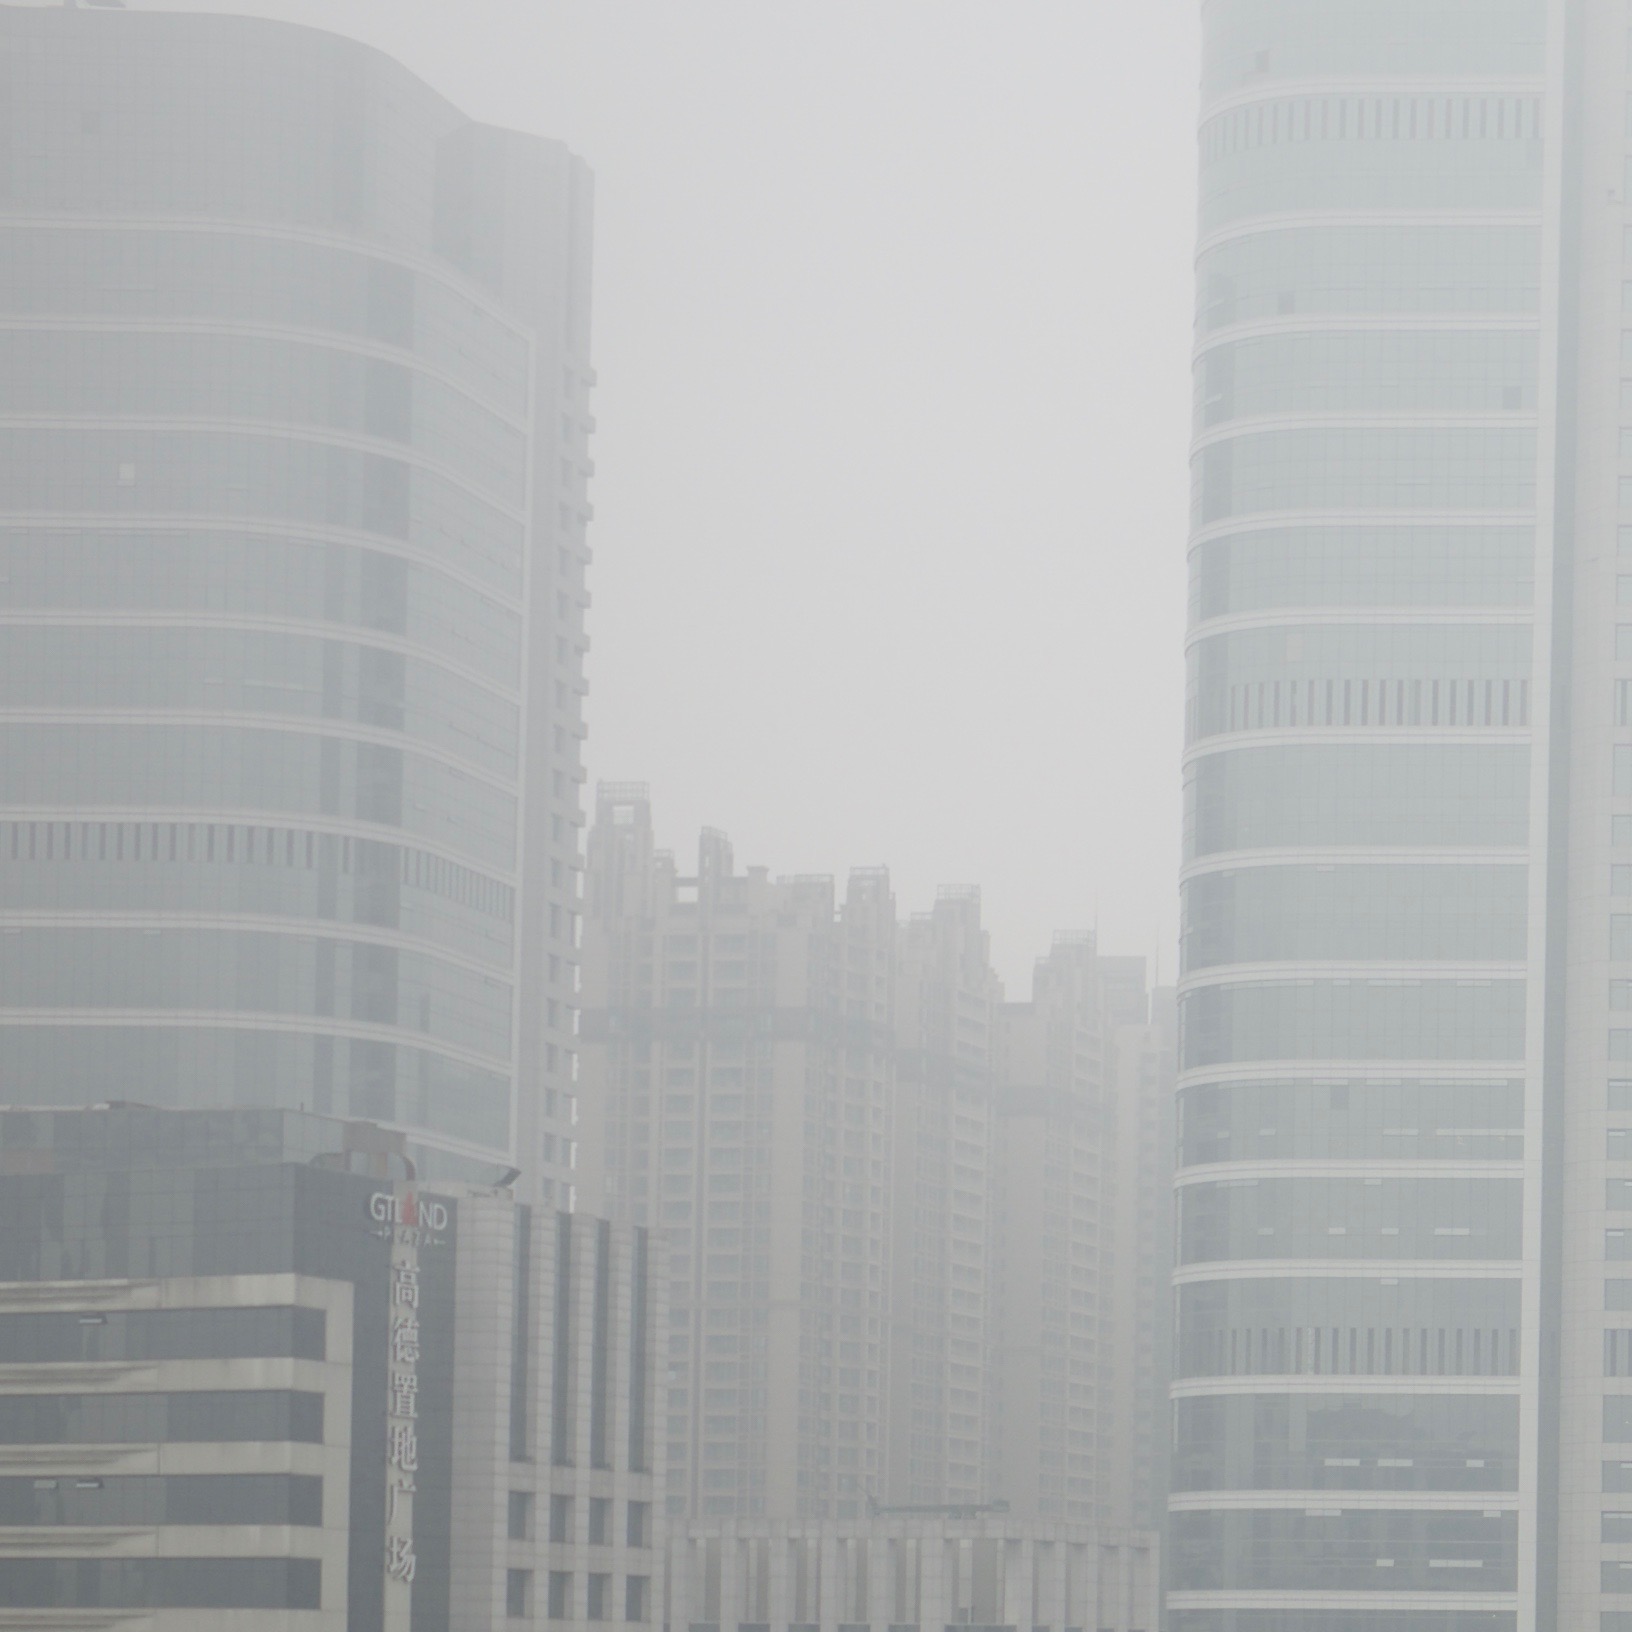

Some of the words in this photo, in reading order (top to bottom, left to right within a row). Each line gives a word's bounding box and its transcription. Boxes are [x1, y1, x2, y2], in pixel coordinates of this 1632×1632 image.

[386, 1260, 420, 1584] 高德置地广场
